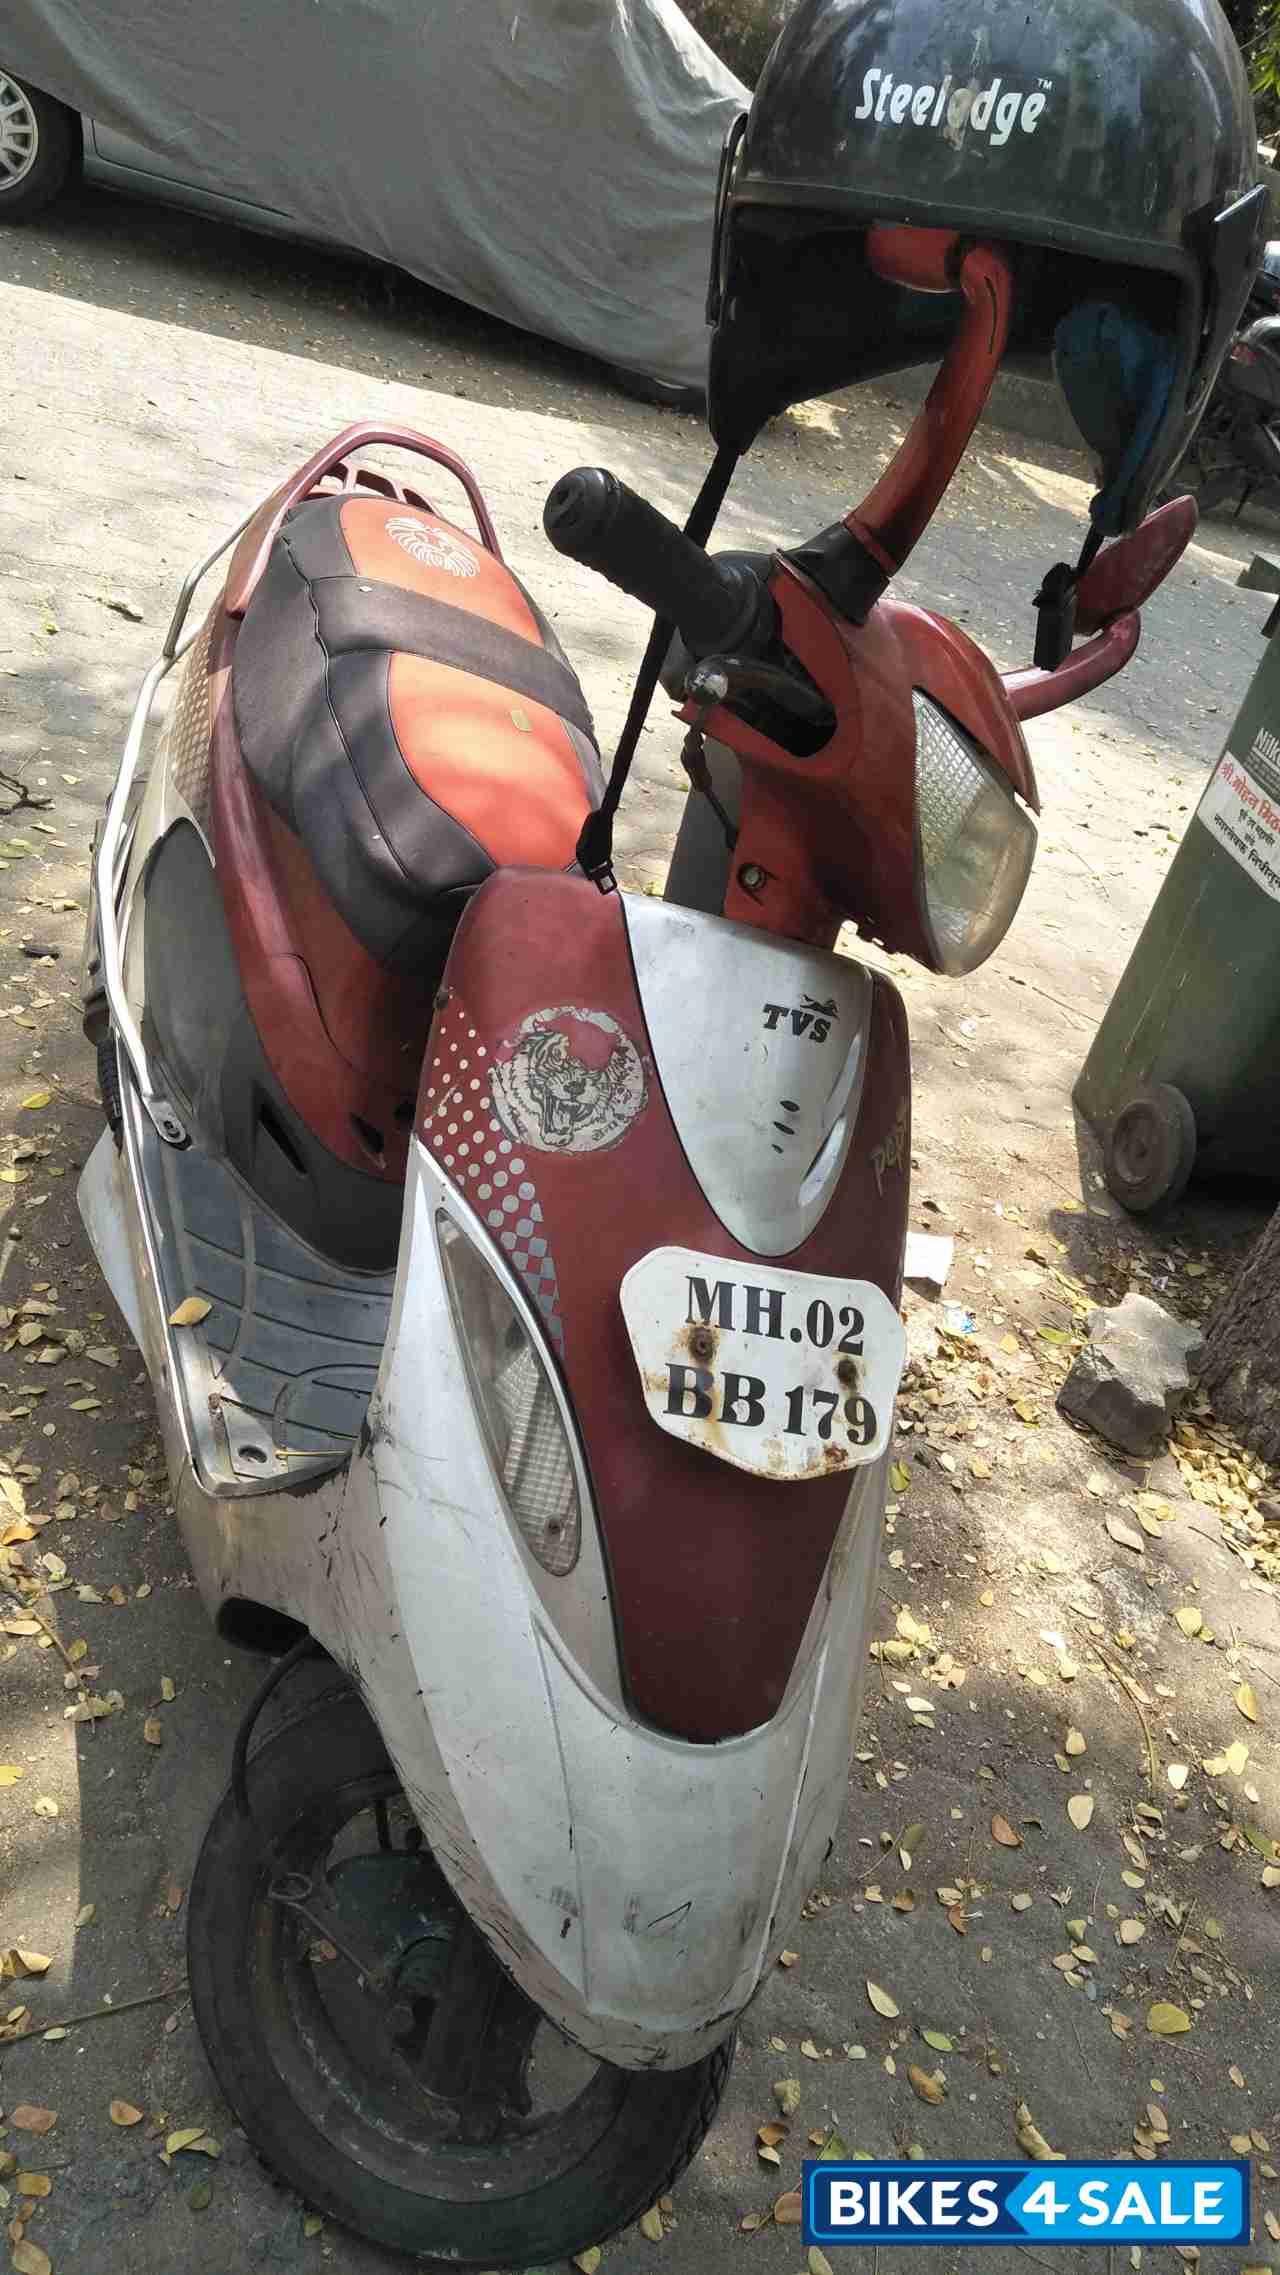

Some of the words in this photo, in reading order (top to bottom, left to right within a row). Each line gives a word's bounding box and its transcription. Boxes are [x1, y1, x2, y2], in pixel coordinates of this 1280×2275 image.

[763, 1003, 831, 1044] TVS
[685, 1276, 865, 1356] MH.02
[783, 1385, 878, 1446] 179
